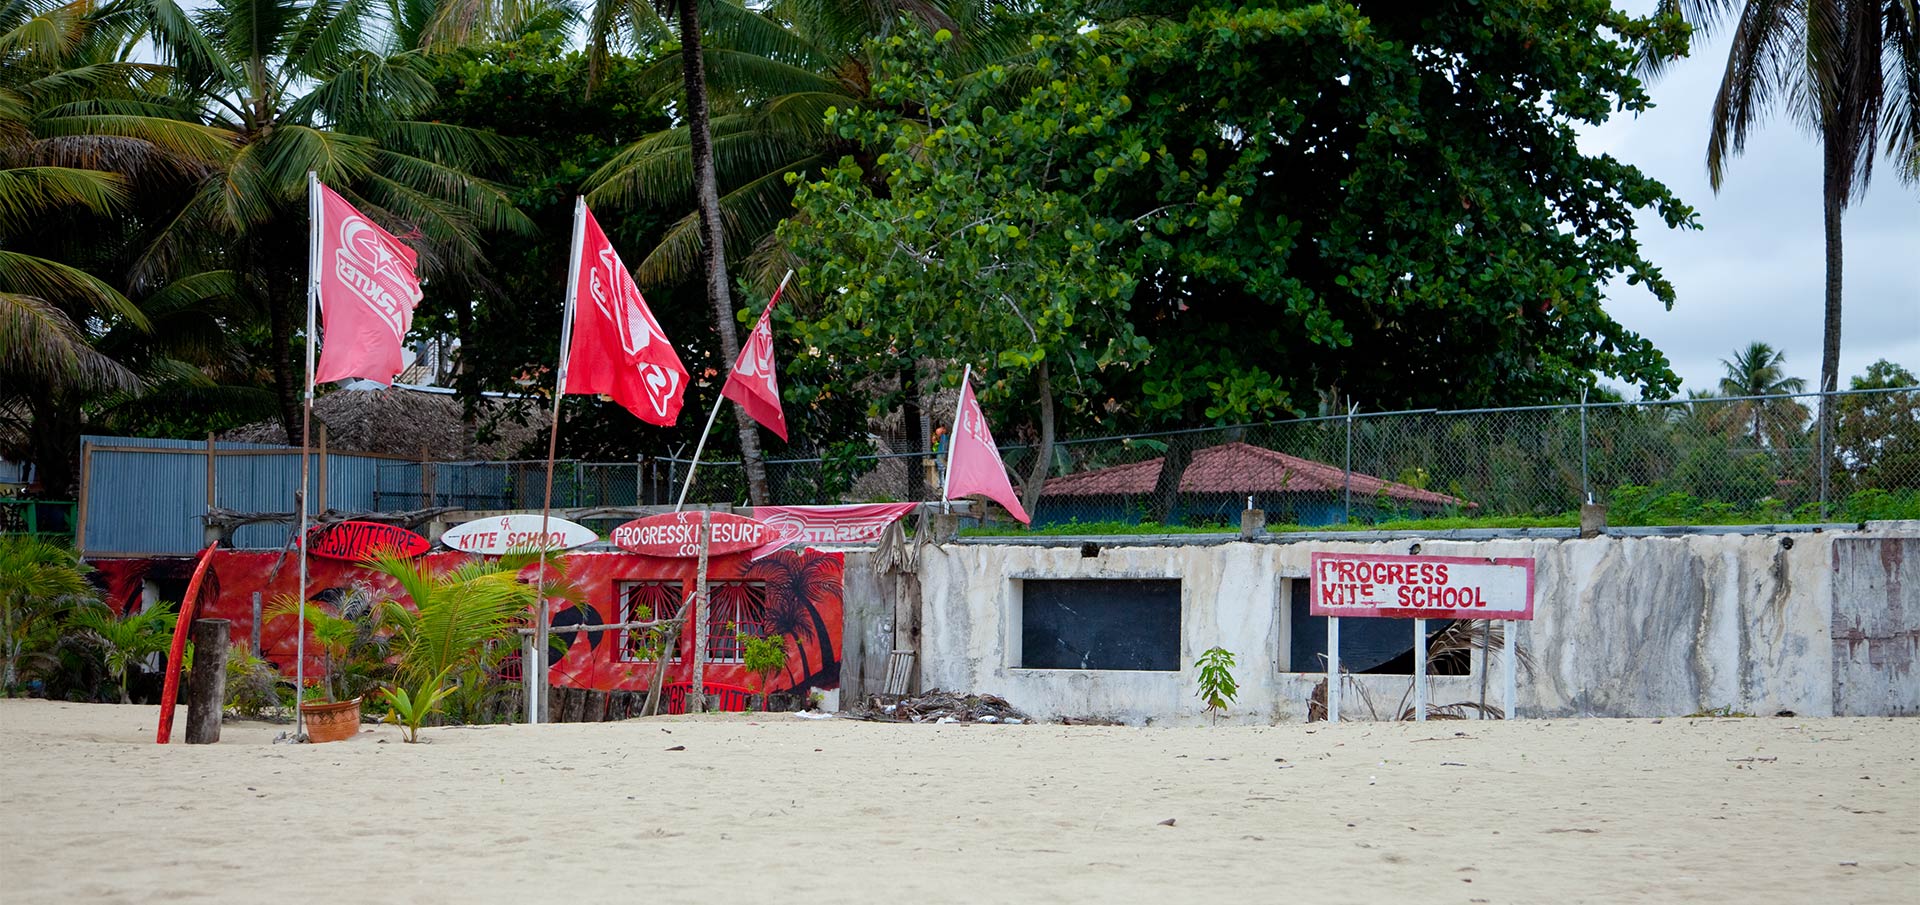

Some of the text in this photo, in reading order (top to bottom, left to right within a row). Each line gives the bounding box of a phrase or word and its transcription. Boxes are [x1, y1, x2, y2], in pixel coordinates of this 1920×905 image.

[459, 531, 568, 550] KITE SCHOOL
[615, 523, 764, 546] PROGRESSKIESURF
[1320, 561, 1449, 586] PROGRESS
[1397, 585, 1487, 608] SCHOOL
